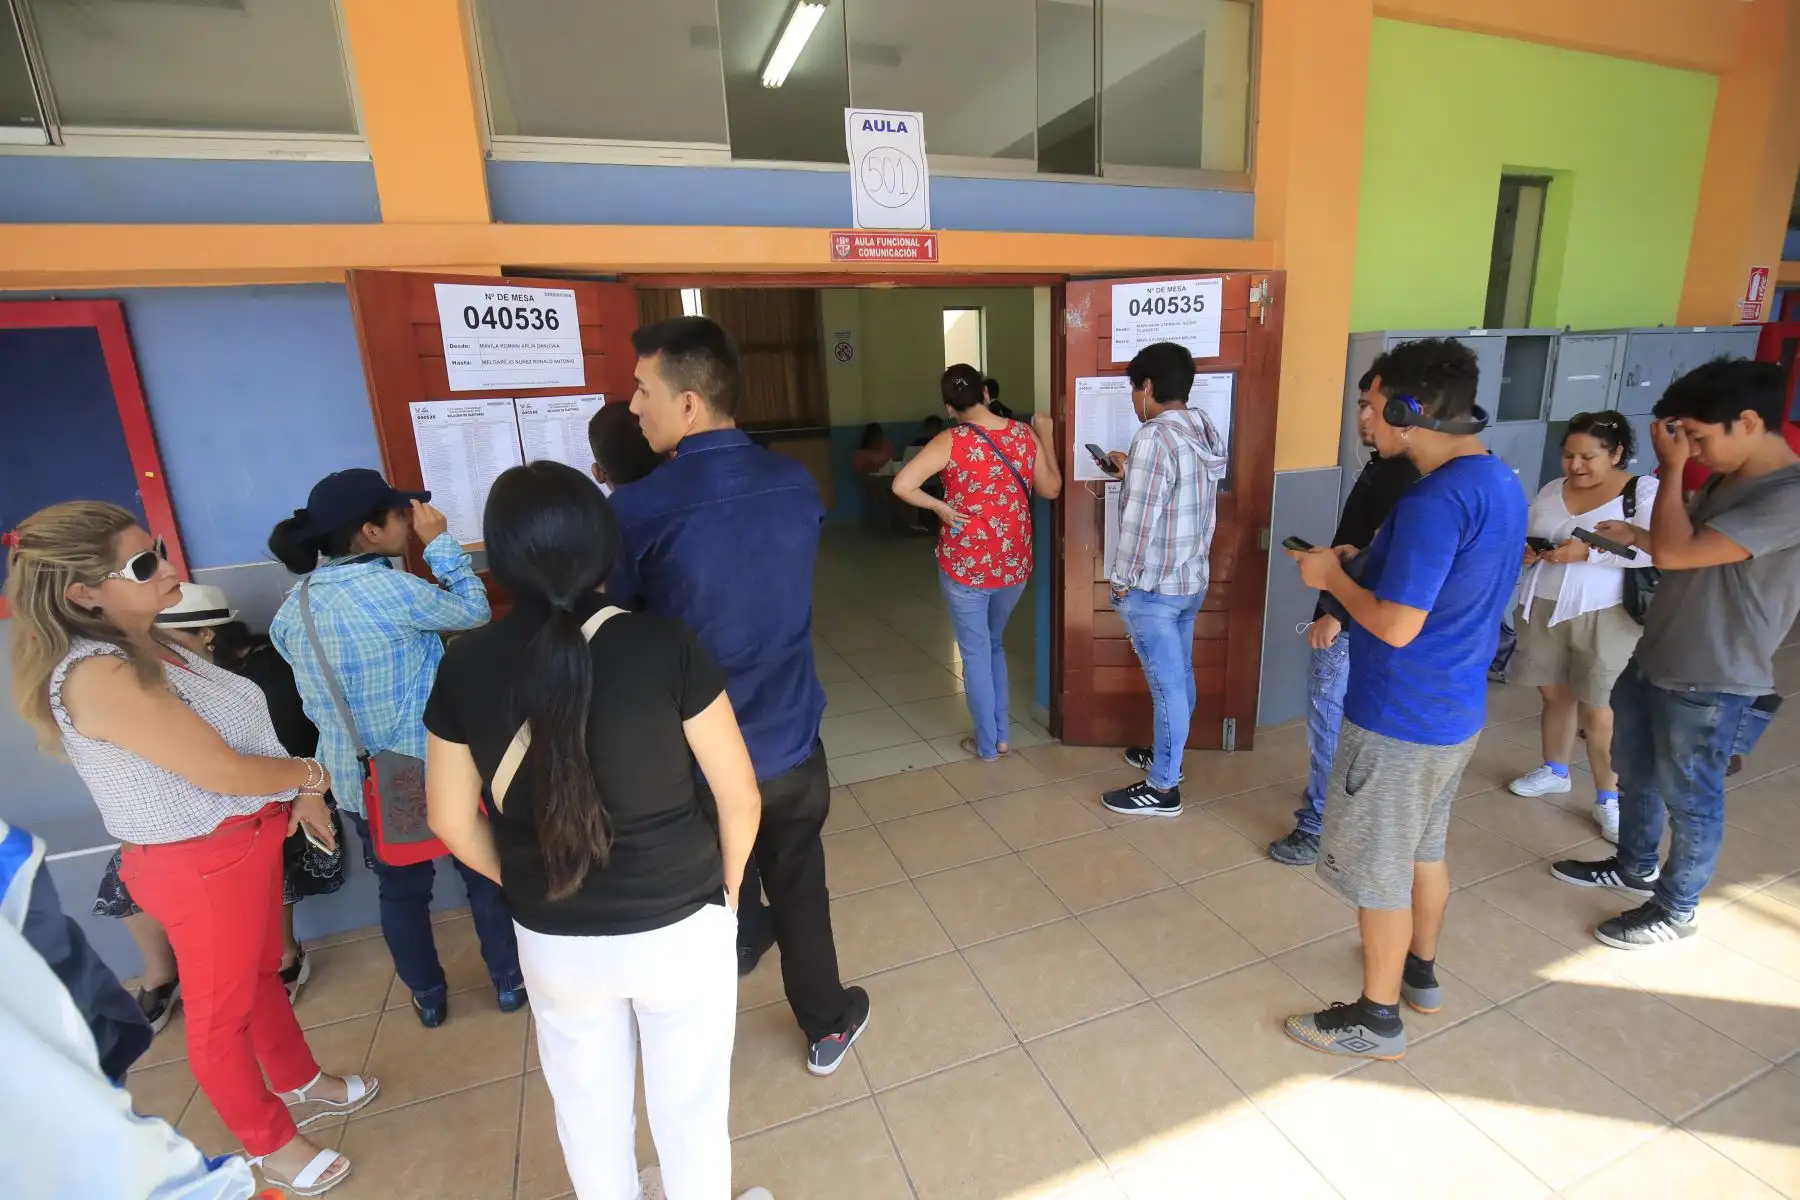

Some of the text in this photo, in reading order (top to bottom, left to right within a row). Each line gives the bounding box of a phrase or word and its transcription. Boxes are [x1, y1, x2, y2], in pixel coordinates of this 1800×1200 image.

[862, 119, 908, 133] AULA
[869, 156, 908, 194] 501
[855, 237, 919, 246] AULA FUNCIONAL
[924, 238, 933, 258] 1
[858, 247, 917, 257] COMUNICACIÓN
[511, 294, 534, 302] MESA
[1129, 295, 1205, 316] 040535
[463, 305, 560, 331] 040536
